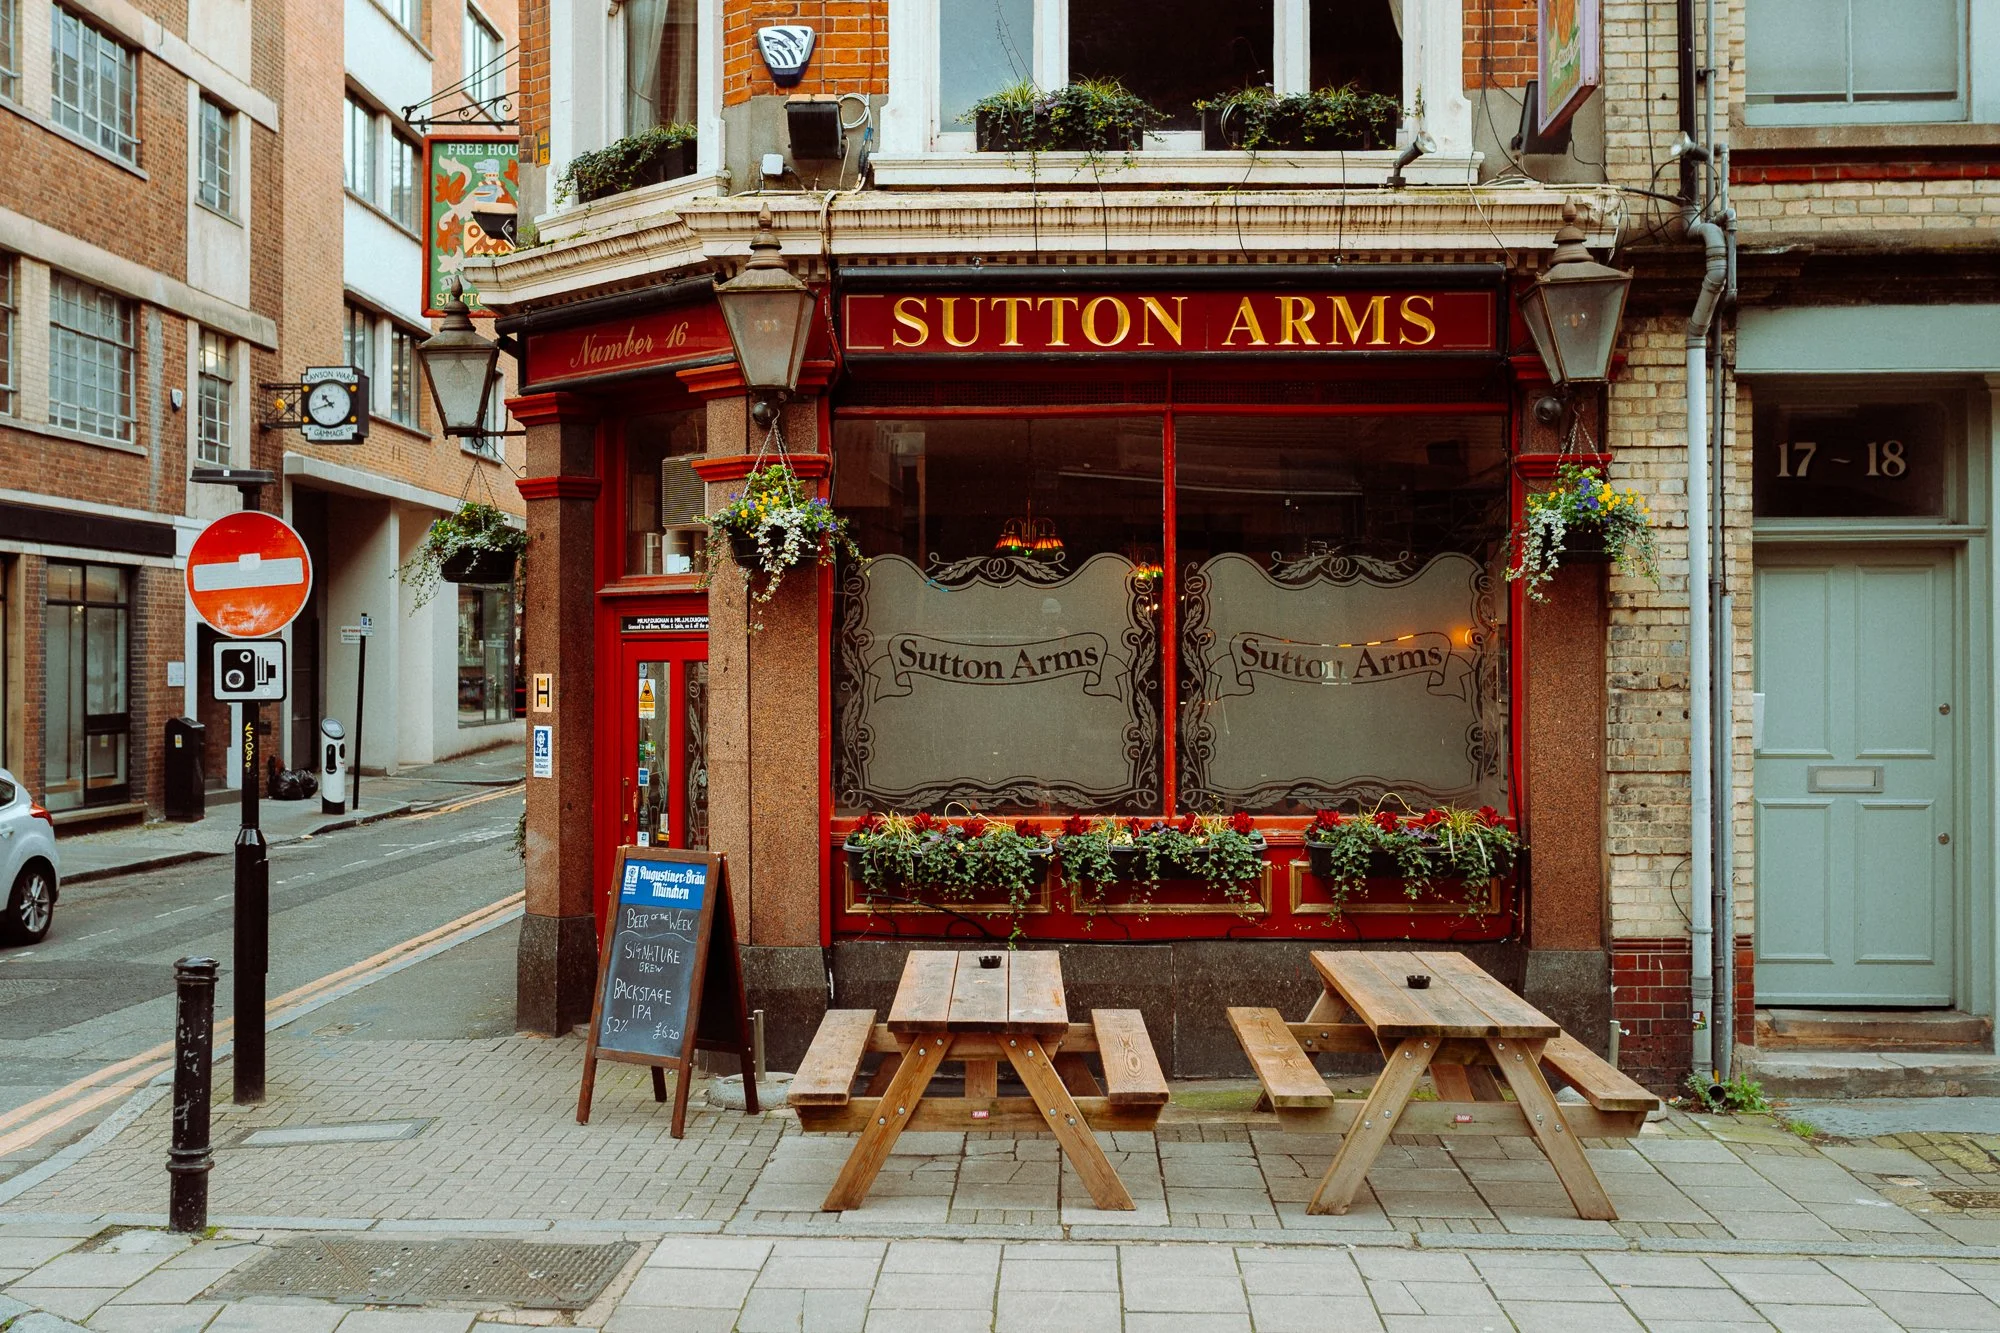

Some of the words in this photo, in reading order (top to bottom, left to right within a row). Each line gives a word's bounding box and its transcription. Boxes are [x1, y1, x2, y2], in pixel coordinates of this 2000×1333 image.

[447, 143, 484, 156] FREE
[892, 296, 1188, 347] SUTTON
[1221, 295, 1436, 346] ARMS
[570, 325, 654, 368] Number
[665, 321, 689, 349] 16
[305, 371, 334, 383] LAWSON
[336, 371, 356, 383] WARD
[1776, 441, 1817, 478] 17
[1865, 440, 1907, 477] 18
[898, 638, 1005, 680] Sutton
[1010, 646, 1099, 679] Arms
[1241, 638, 1348, 680] Sutton
[1353, 646, 1443, 679] Arms
[652, 881, 690, 900] München
[626, 907, 649, 929] BEER
[659, 913, 669, 921] THE
[669, 910, 693, 931] WEEK
[625, 940, 681, 965] SIGNATURE
[638, 961, 664, 973] BREW
[613, 977, 672, 1005] BACKSTAGE
[631, 1004, 652, 1021] IPA
